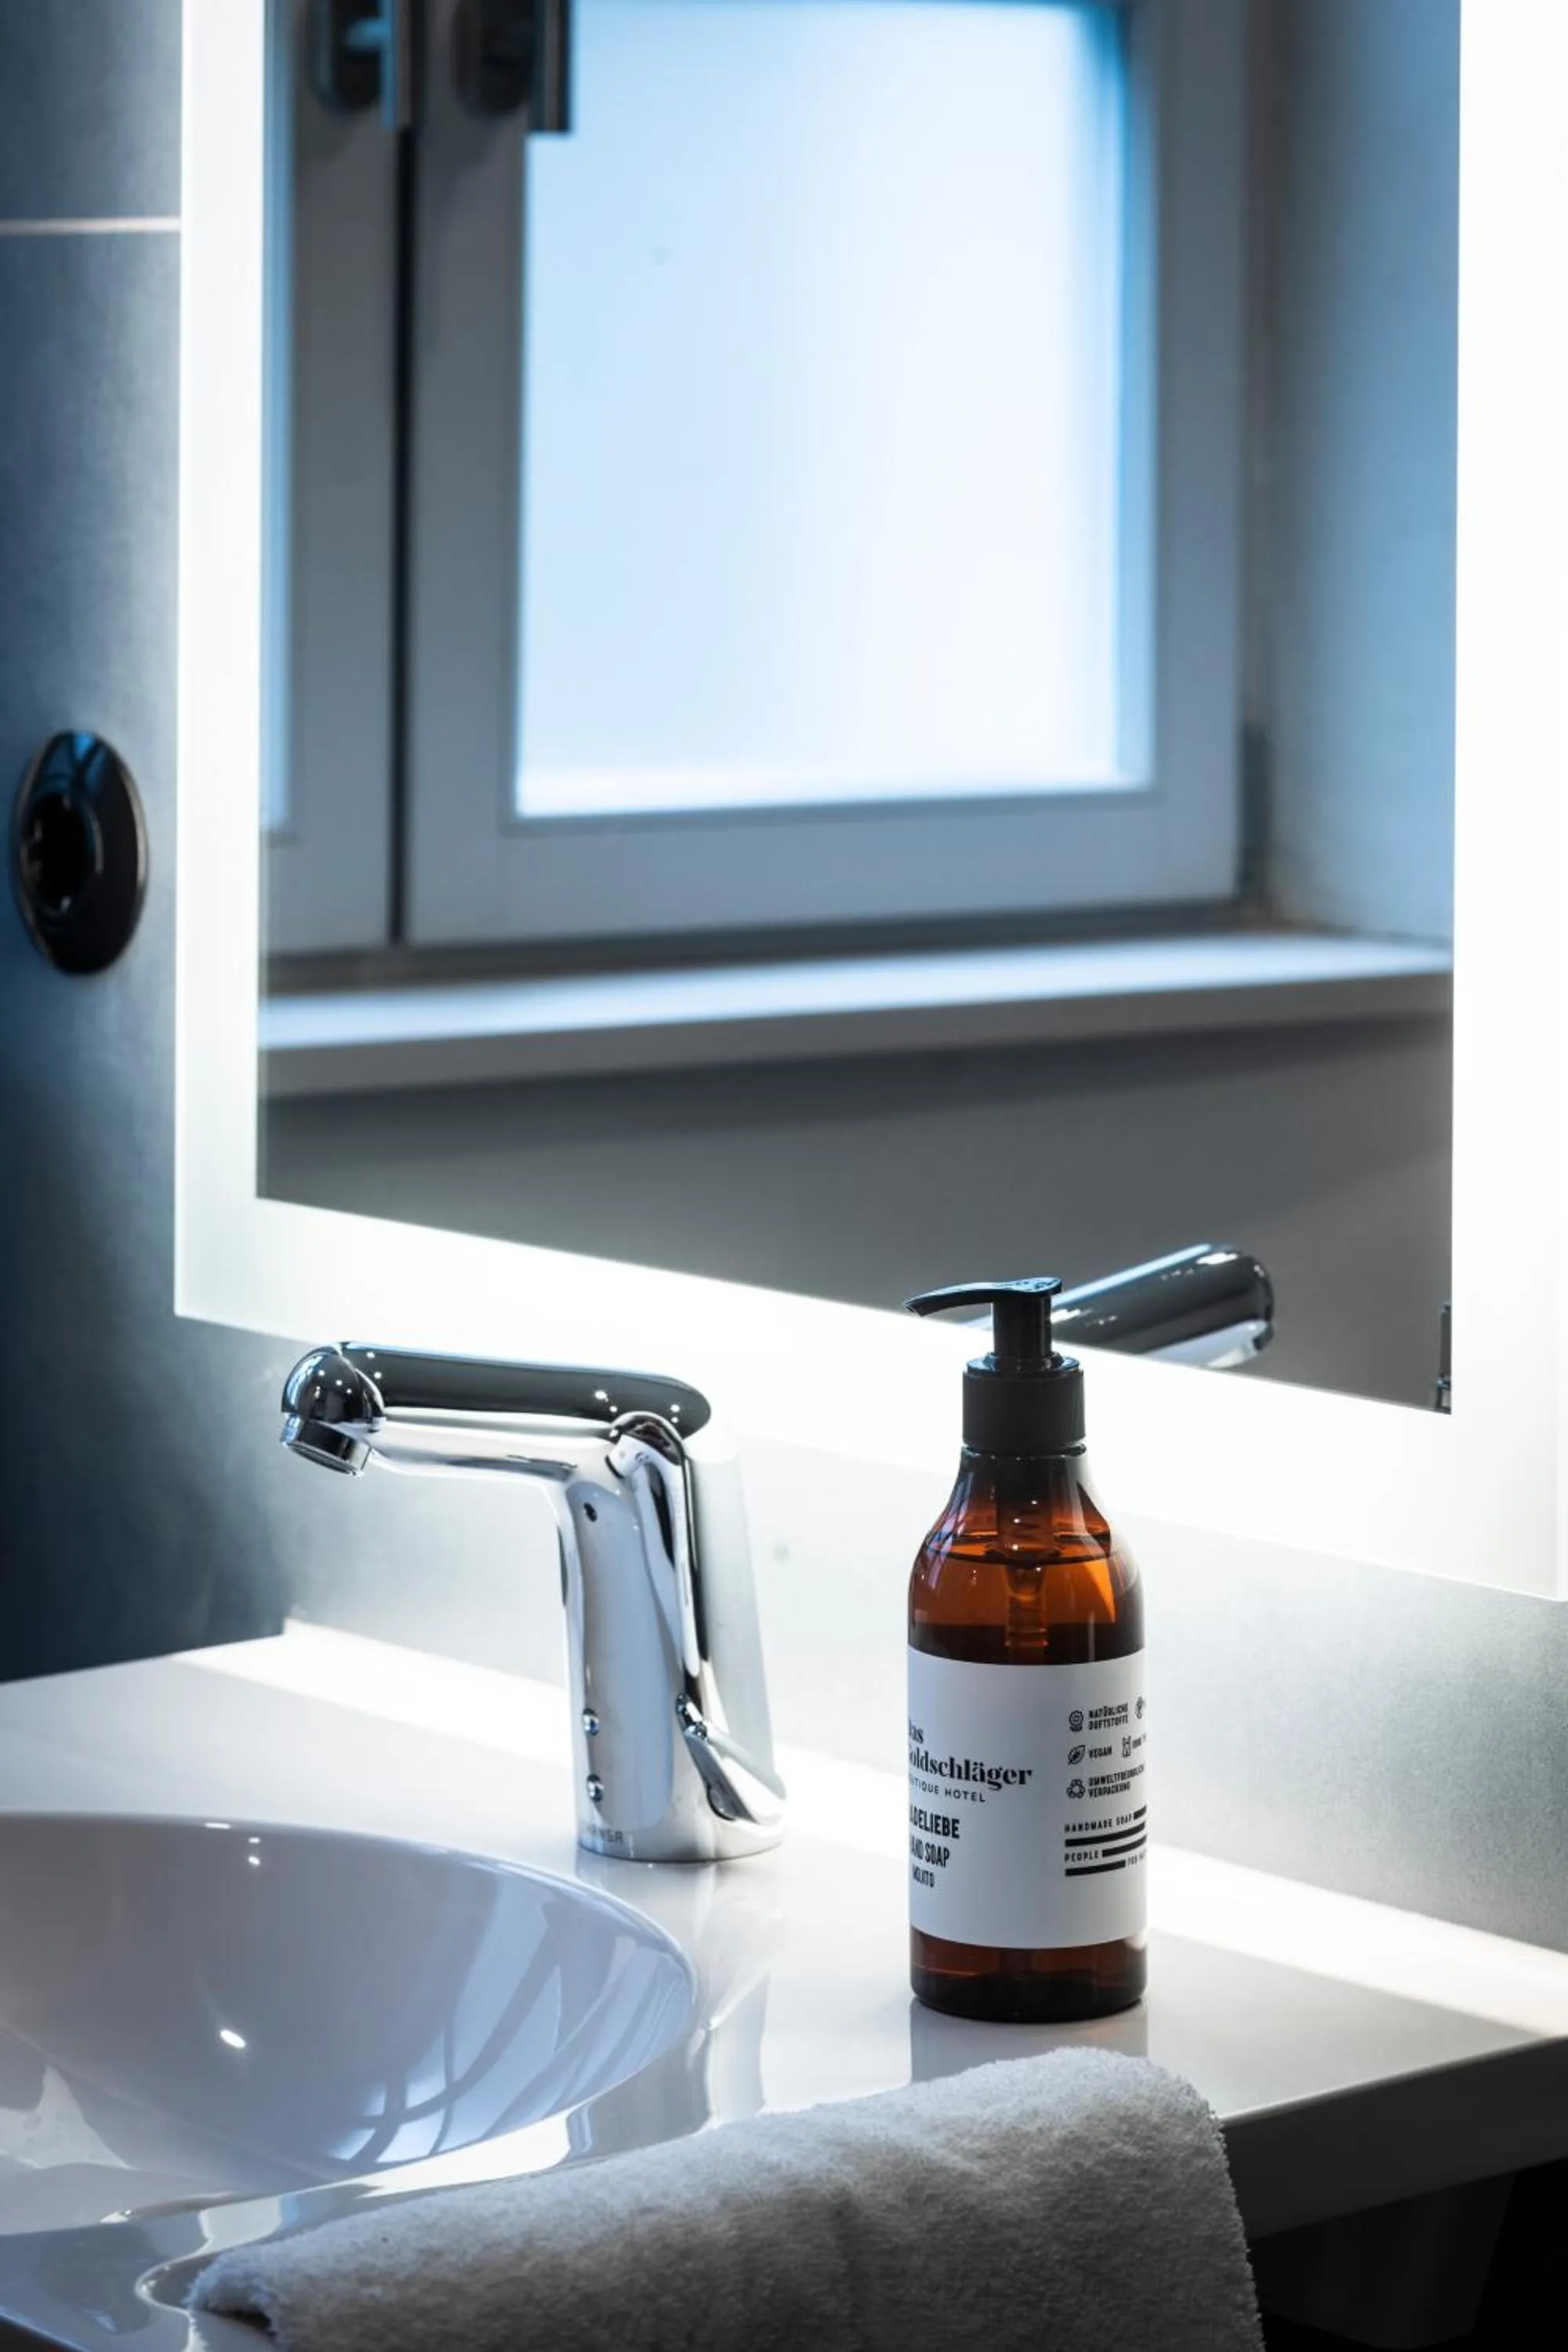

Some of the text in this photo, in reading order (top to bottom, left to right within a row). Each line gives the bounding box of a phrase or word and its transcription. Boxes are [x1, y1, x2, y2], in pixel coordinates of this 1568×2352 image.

[1088, 1745, 1112, 1759] VEGAN
[909, 1744, 1033, 1791] oldschläger
[946, 1788, 985, 1802] HOTEL
[1065, 1812, 1132, 1833] HANDMADE SOAP
[925, 1842, 950, 1868] SOAP
[1065, 1849, 1099, 1864] PEOPLE
